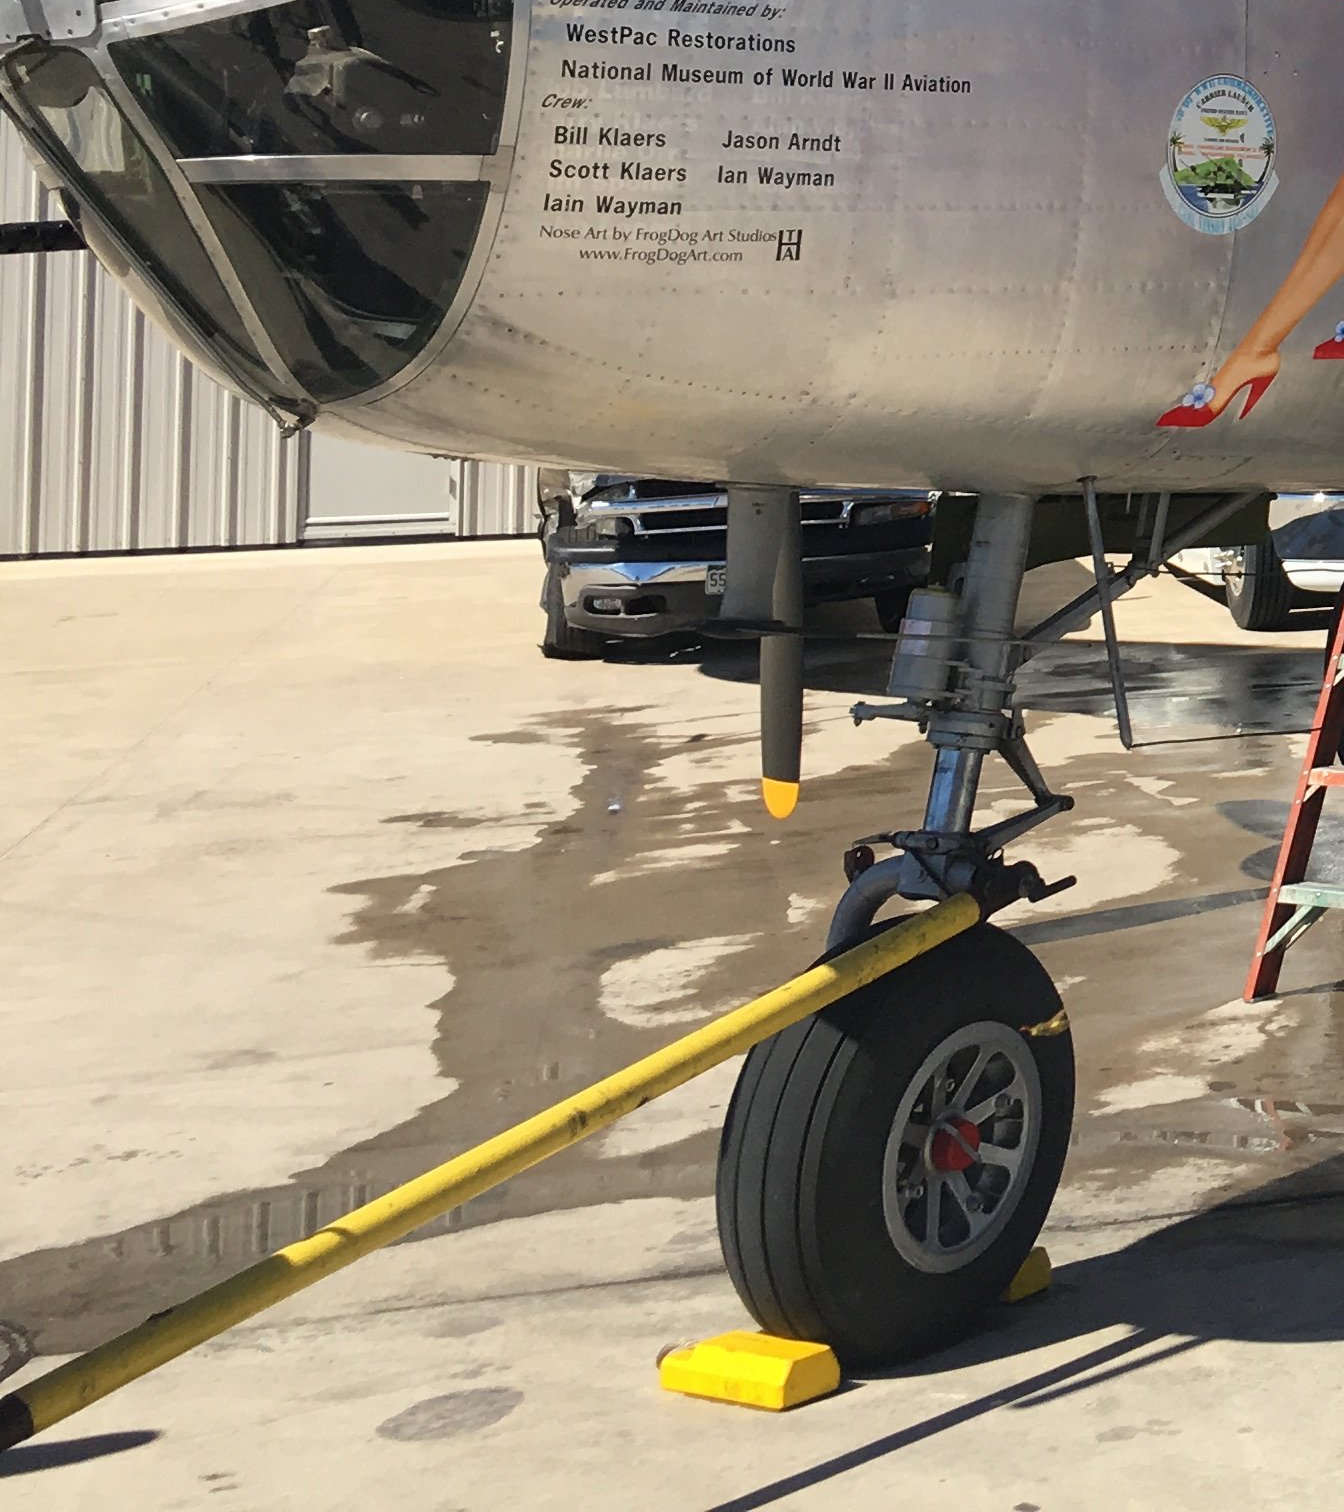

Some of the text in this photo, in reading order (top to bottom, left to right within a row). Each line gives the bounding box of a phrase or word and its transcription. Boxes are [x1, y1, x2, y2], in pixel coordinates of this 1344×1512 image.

[758, 2, 787, 21] by:
[566, 22, 796, 54] WestPac Restorations
[561, 59, 971, 94] National Museum of World War II Aviation
[541, 92, 593, 110] Crew:
[553, 125, 667, 148] Bill Klaers
[721, 129, 842, 153] Jason Arndt
[548, 158, 687, 182] Scott Klaers
[717, 164, 835, 190] Ian Wayman
[543, 193, 682, 219] Iain Wayman
[539, 224, 777, 247] Nose Art by FrogDog Art Studios
[579, 247, 743, 266] www.FrogDogArt.com
